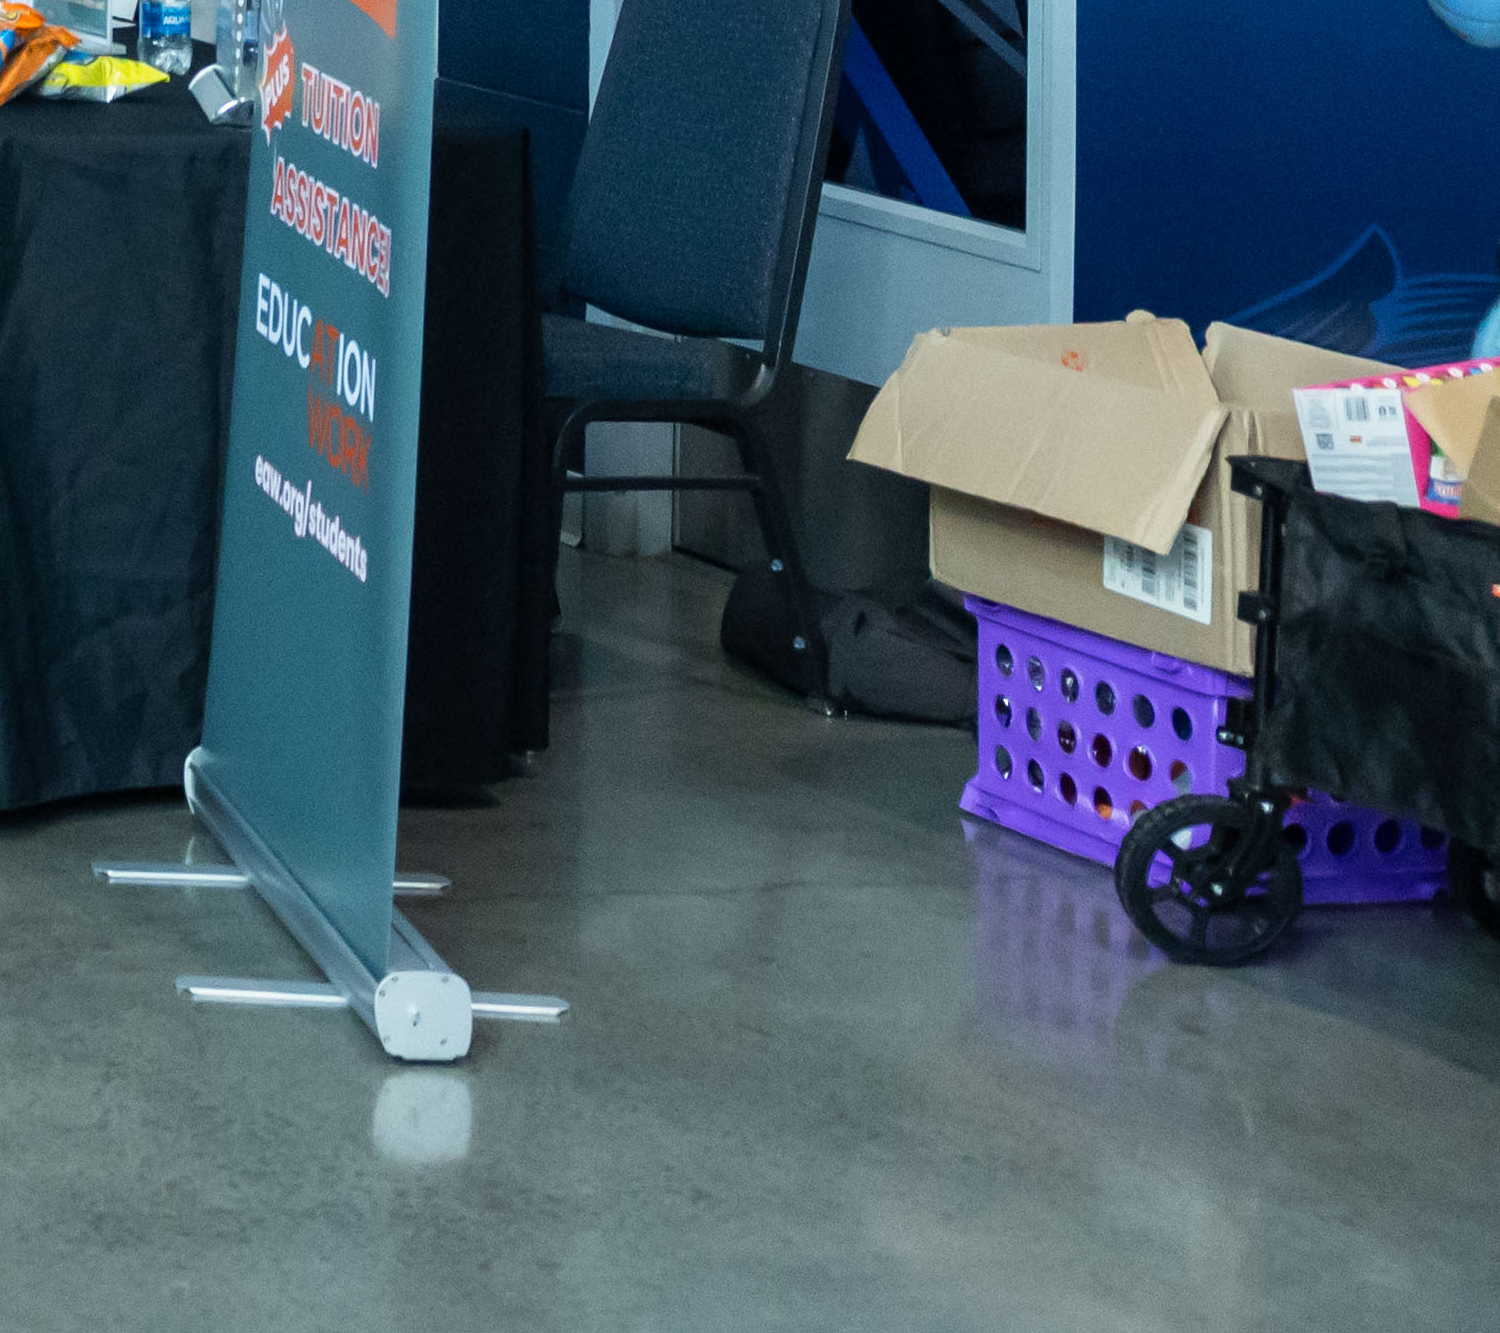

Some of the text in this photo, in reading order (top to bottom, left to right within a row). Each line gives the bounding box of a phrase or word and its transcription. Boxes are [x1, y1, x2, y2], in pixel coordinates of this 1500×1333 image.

[263, 53, 291, 112] PLUS
[300, 61, 380, 170] TUITION
[255, 272, 377, 423] EDUCATION
[307, 383, 373, 496] WORK
[254, 454, 368, 583] eaw.org/students
